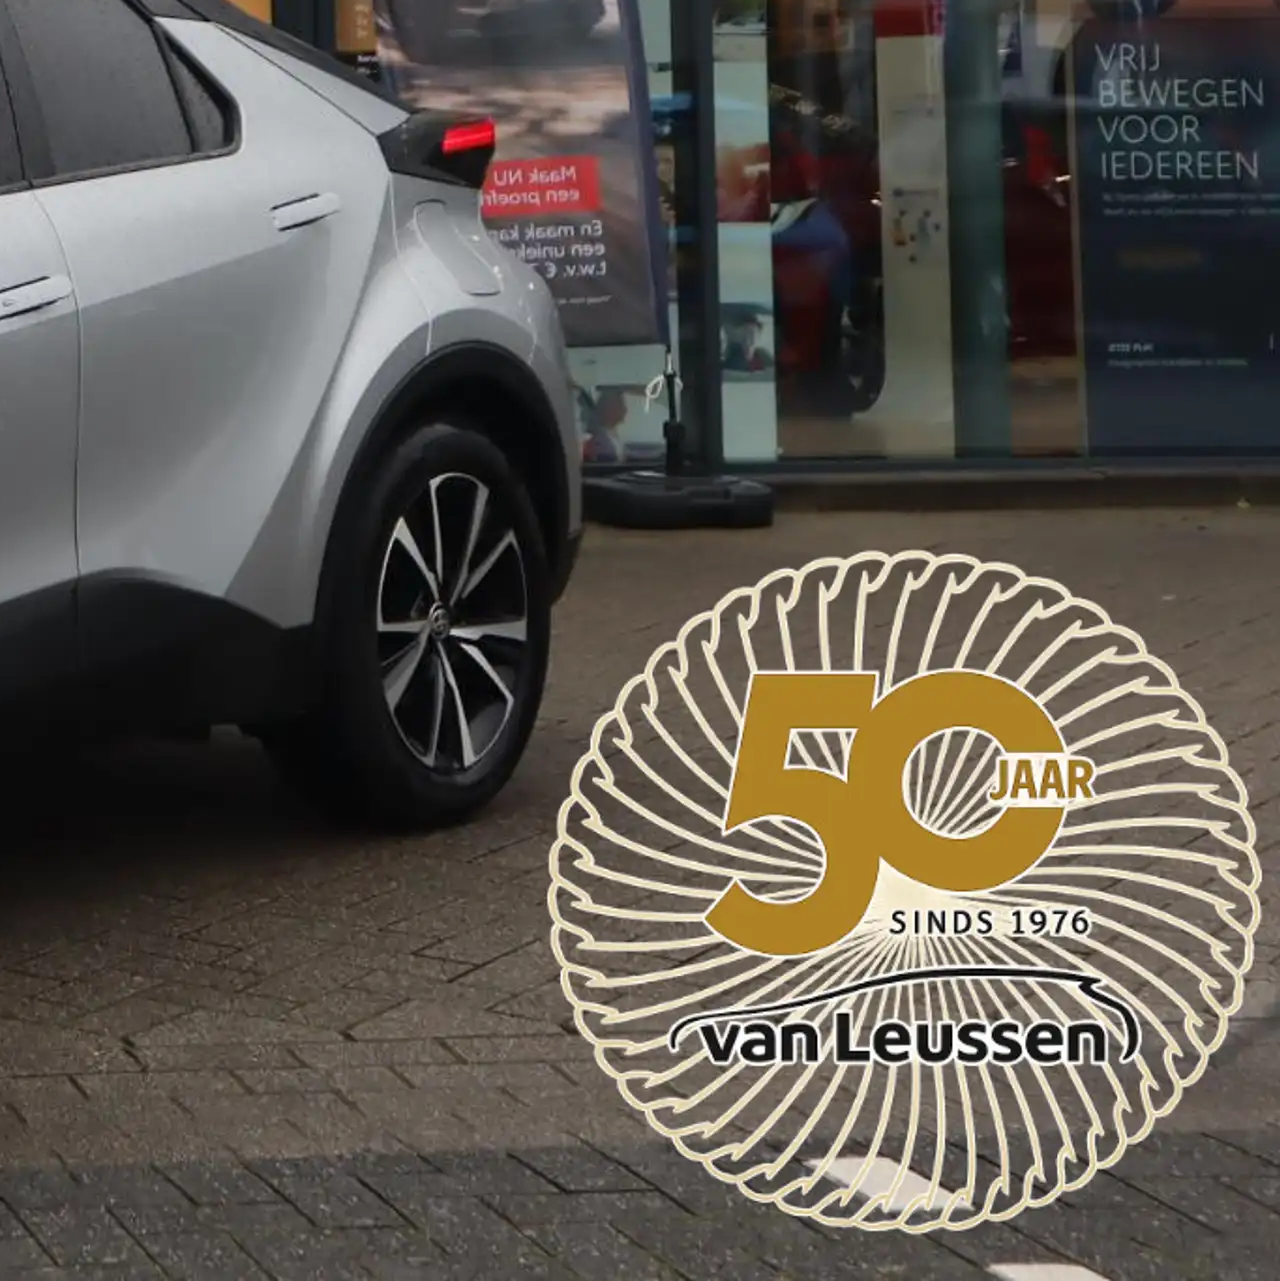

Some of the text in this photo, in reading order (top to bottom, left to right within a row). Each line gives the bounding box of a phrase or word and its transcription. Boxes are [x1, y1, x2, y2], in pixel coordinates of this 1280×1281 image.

[1094, 43, 1161, 71] VRIJ
[1098, 78, 1265, 108] BEWEGEN
[1097, 114, 1202, 144] VOOR
[1100, 150, 1259, 180] IEDEREEN
